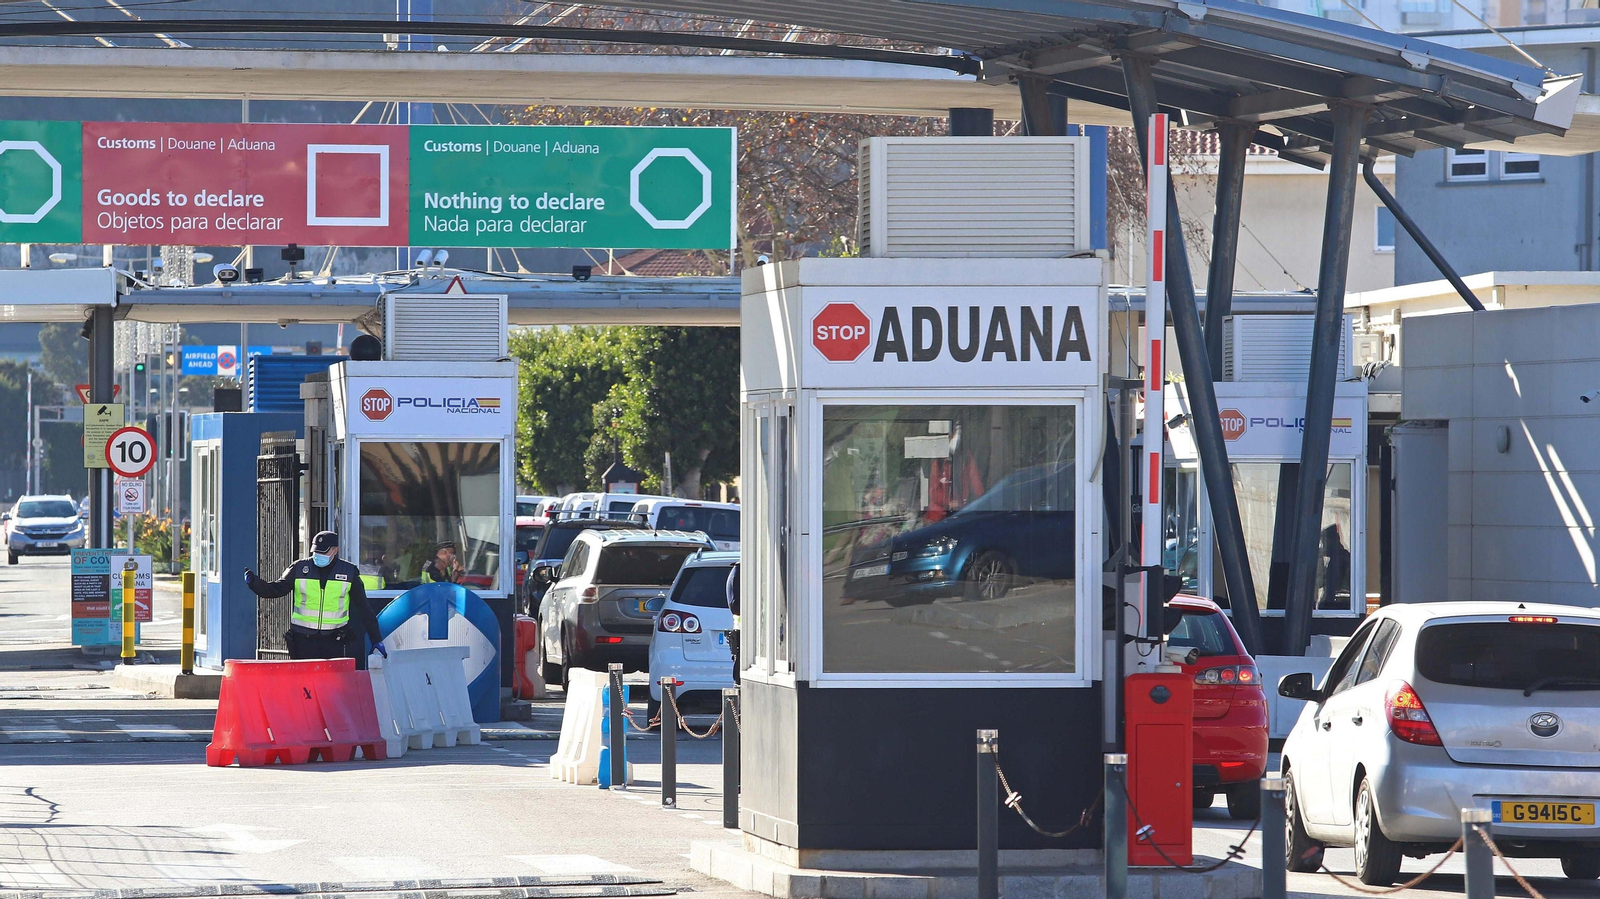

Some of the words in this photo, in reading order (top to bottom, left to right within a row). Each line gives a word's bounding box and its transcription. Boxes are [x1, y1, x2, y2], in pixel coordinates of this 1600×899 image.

[97, 136, 156, 150] Customs
[168, 137, 216, 150] Douane
[227, 138, 276, 151] Aduana
[424, 139, 482, 153] Customs
[493, 141, 541, 153] Douane
[552, 141, 600, 154] Aduana
[97, 189, 160, 207] Goods
[167, 190, 188, 207] to
[193, 189, 265, 207] declare
[424, 192, 502, 213] Nothing
[509, 194, 530, 210] to
[535, 193, 605, 211] declare
[97, 211, 164, 232] Objetos
[170, 215, 208, 233] para
[215, 212, 283, 230] declarar
[424, 215, 469, 232] Nada
[476, 218, 513, 236] para
[520, 215, 587, 233] declarar
[816, 325, 866, 340] STOP
[872, 305, 1092, 363] ADUANA
[185, 352, 217, 360] AIRFIELD
[363, 397, 390, 412] STOP
[116, 440, 147, 464] 10
[73, 556, 87, 565] OF
